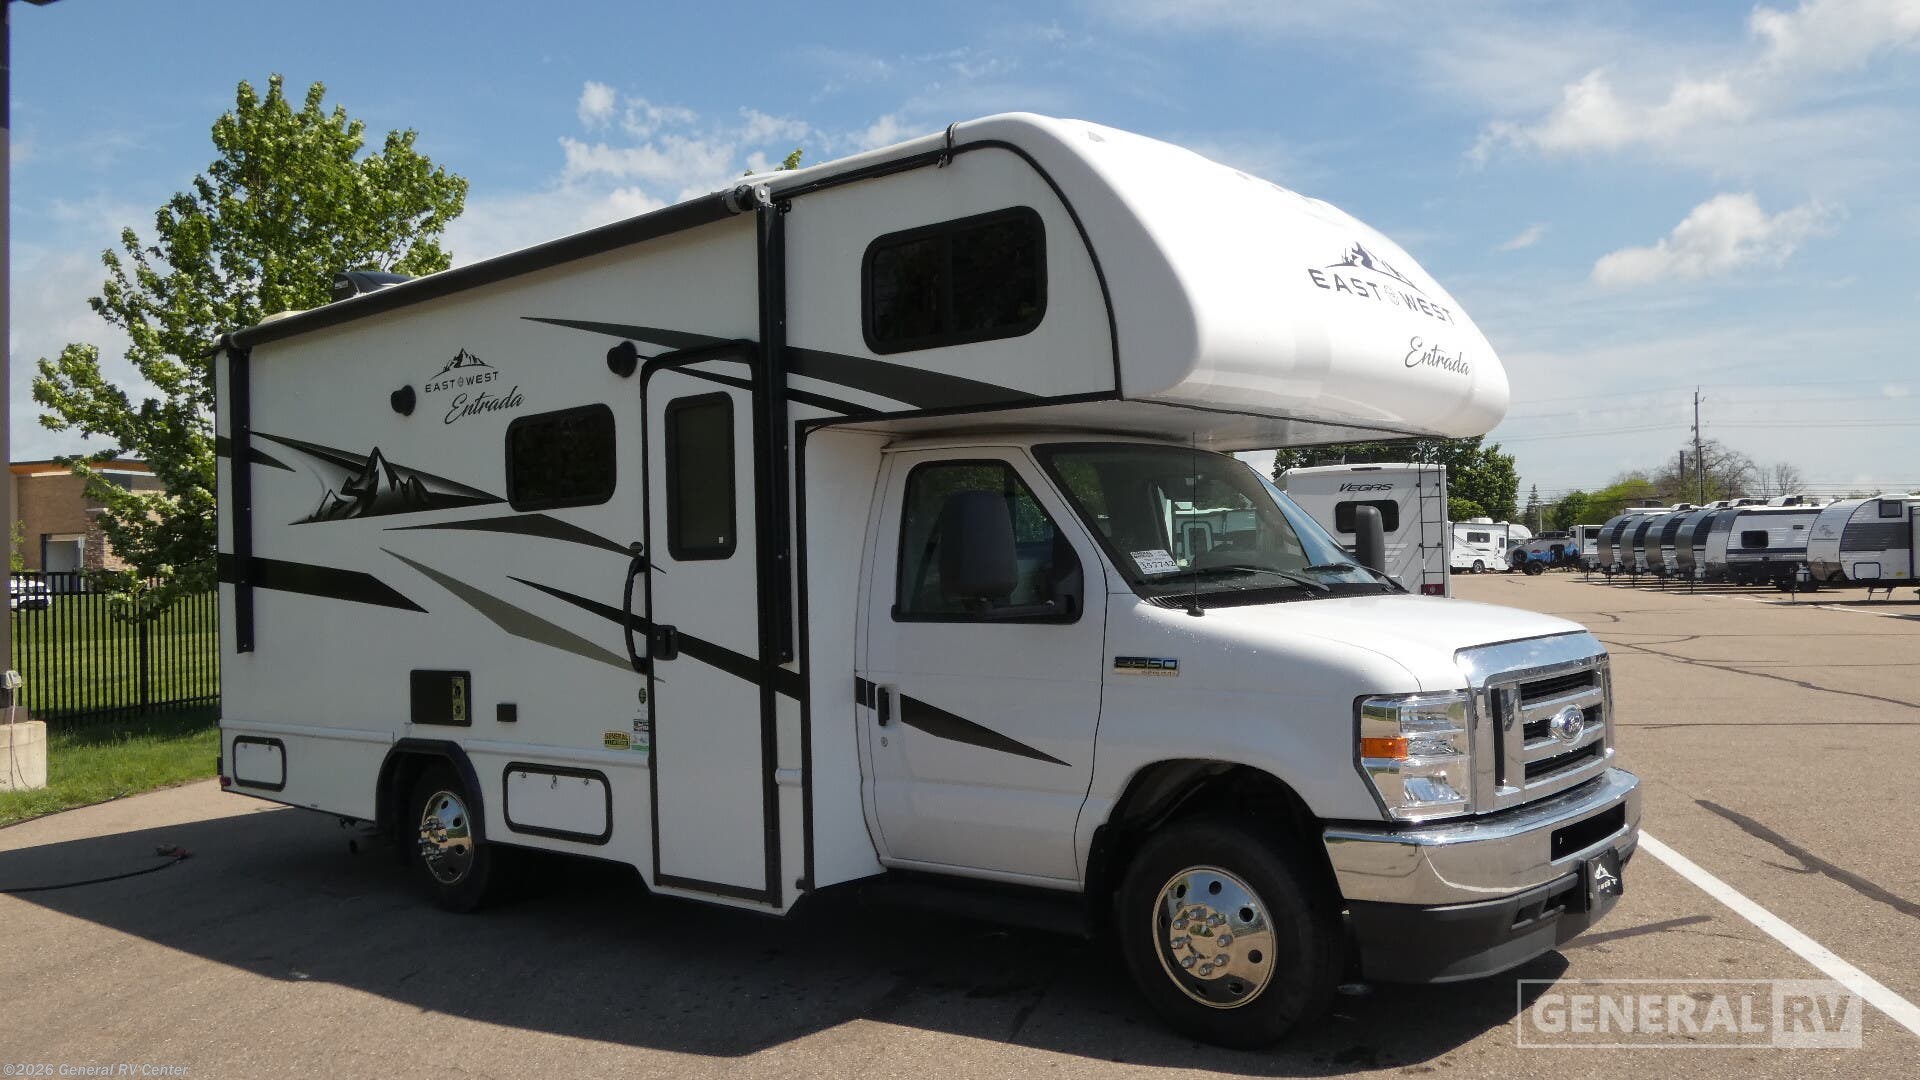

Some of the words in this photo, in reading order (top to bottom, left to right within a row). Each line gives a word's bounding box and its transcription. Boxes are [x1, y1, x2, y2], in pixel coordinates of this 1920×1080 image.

[1307, 268, 1382, 302] EAST
[1399, 290, 1455, 325] WEST
[1404, 335, 1470, 376] Entrada
[425, 379, 456, 393] EAST
[466, 371, 498, 386] WEST
[444, 385, 524, 425] Entrada
[1339, 482, 1394, 492] VEGAS
